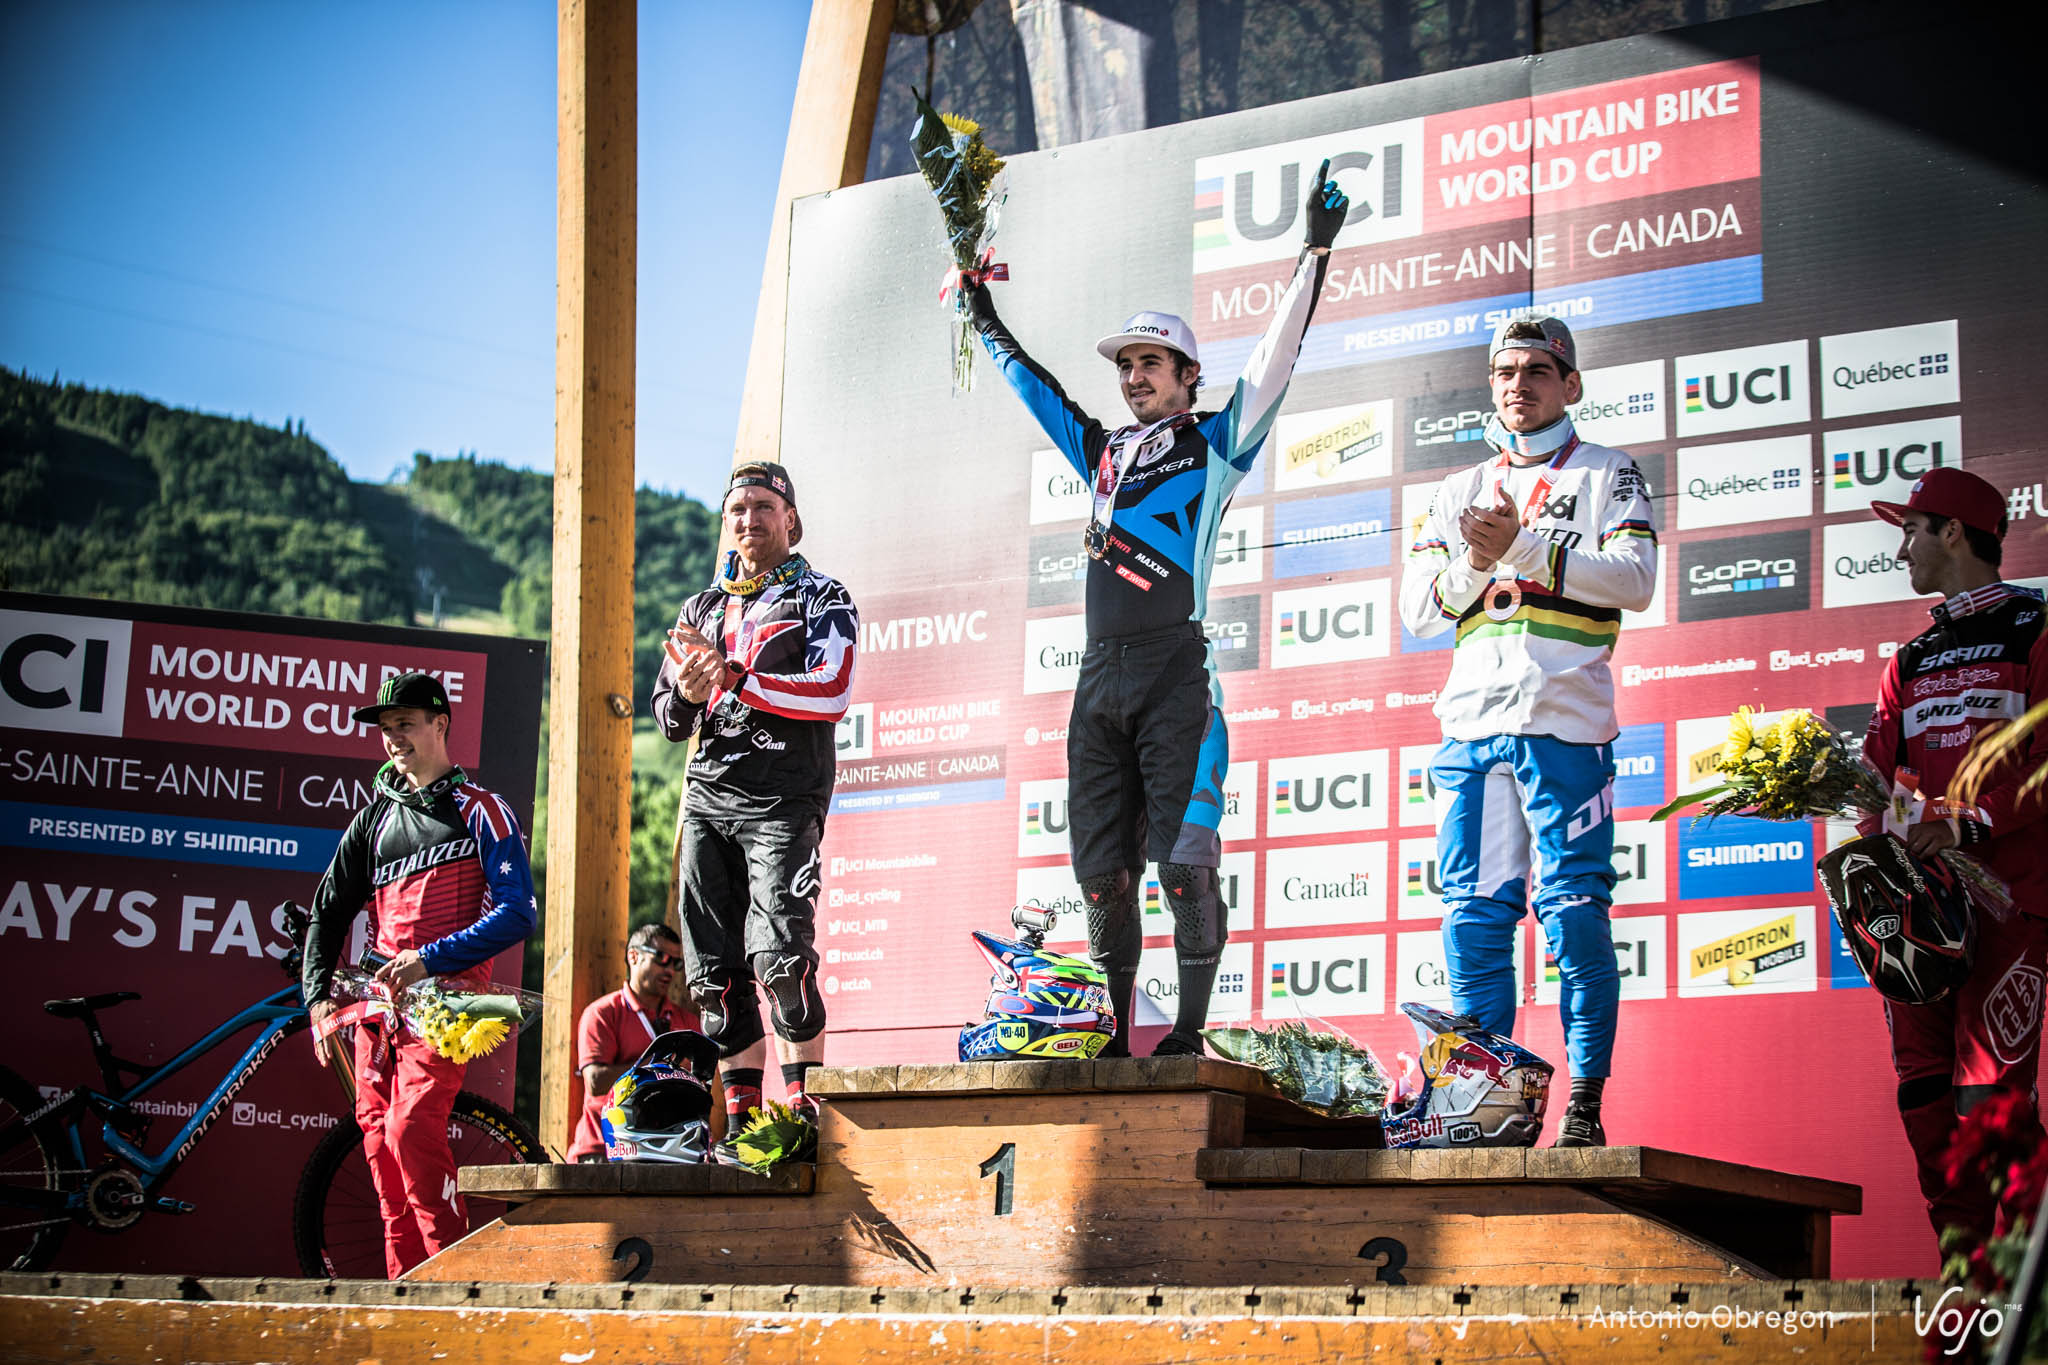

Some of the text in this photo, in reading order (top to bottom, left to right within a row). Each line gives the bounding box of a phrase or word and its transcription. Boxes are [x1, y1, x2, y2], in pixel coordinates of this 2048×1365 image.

[1441, 80, 1741, 166] MOUNTAIN BIKE
[1233, 143, 1403, 242] UCI
[1439, 140, 1662, 210] WORLD CUP
[1211, 203, 1742, 322] MON-SAINTE-ANNE CANADA
[1344, 317, 1449, 353] PRESENTED
[1454, 312, 1481, 338] BY
[1705, 364, 1792, 410] UCI
[1833, 361, 1917, 389] Québec
[1414, 410, 1497, 435] GoPr
[1571, 400, 1625, 424] uébec
[1291, 417, 1371, 464] VIDÉOTRON
[1855, 441, 1944, 487] UCI
[1047, 473, 1088, 498] Can
[1688, 474, 1769, 500] Québec
[1218, 530, 1247, 565] CI
[1282, 520, 1383, 548] SHIMANO
[1038, 551, 1088, 574] GoP
[1135, 552, 1171, 579] MAXXIS
[1688, 557, 1797, 585] GoPro
[1835, 552, 1906, 579] Québe
[729, 582, 754, 594] MITH
[1128, 572, 1151, 590] SWISS
[861, 608, 988, 654] IMTBWC
[1204, 621, 1248, 639] Pro
[1298, 602, 1374, 644] UCI
[0, 633, 110, 714] CI
[149, 643, 368, 696] MOUNTAIN
[1039, 643, 1087, 670] Can
[1916, 643, 2005, 673] SRAM
[145, 686, 291, 731] WORLD
[879, 700, 1001, 728] MOUNTAIN BIKE
[836, 714, 865, 750] CI
[879, 723, 970, 747] WORLD CUP
[937, 754, 1000, 776] CANADA
[299, 774, 380, 812] CAN
[1293, 773, 1372, 813] UCI
[28, 817, 299, 858] PRESENTED BY SHIMANO
[1687, 840, 1804, 869] SHIMANO
[1612, 844, 1647, 882] CI
[1283, 873, 1369, 902] Canada
[1612, 940, 1647, 978] CI
[1695, 923, 1791, 968] VIDÉOTRON
[1758, 940, 1806, 970] MOBILE
[1289, 957, 1368, 998] UCI
[1056, 1040, 1080, 1050] BELL
[257, 1109, 339, 1130] uci_cyclin
[472, 1109, 529, 1153] MAXXIS
[1408, 1113, 1444, 1142] Bull
[1452, 1126, 1480, 1141] 100%
[978, 1142, 1017, 1216] 1
[612, 1237, 654, 1284] 2
[1357, 1236, 1408, 1285] 3
